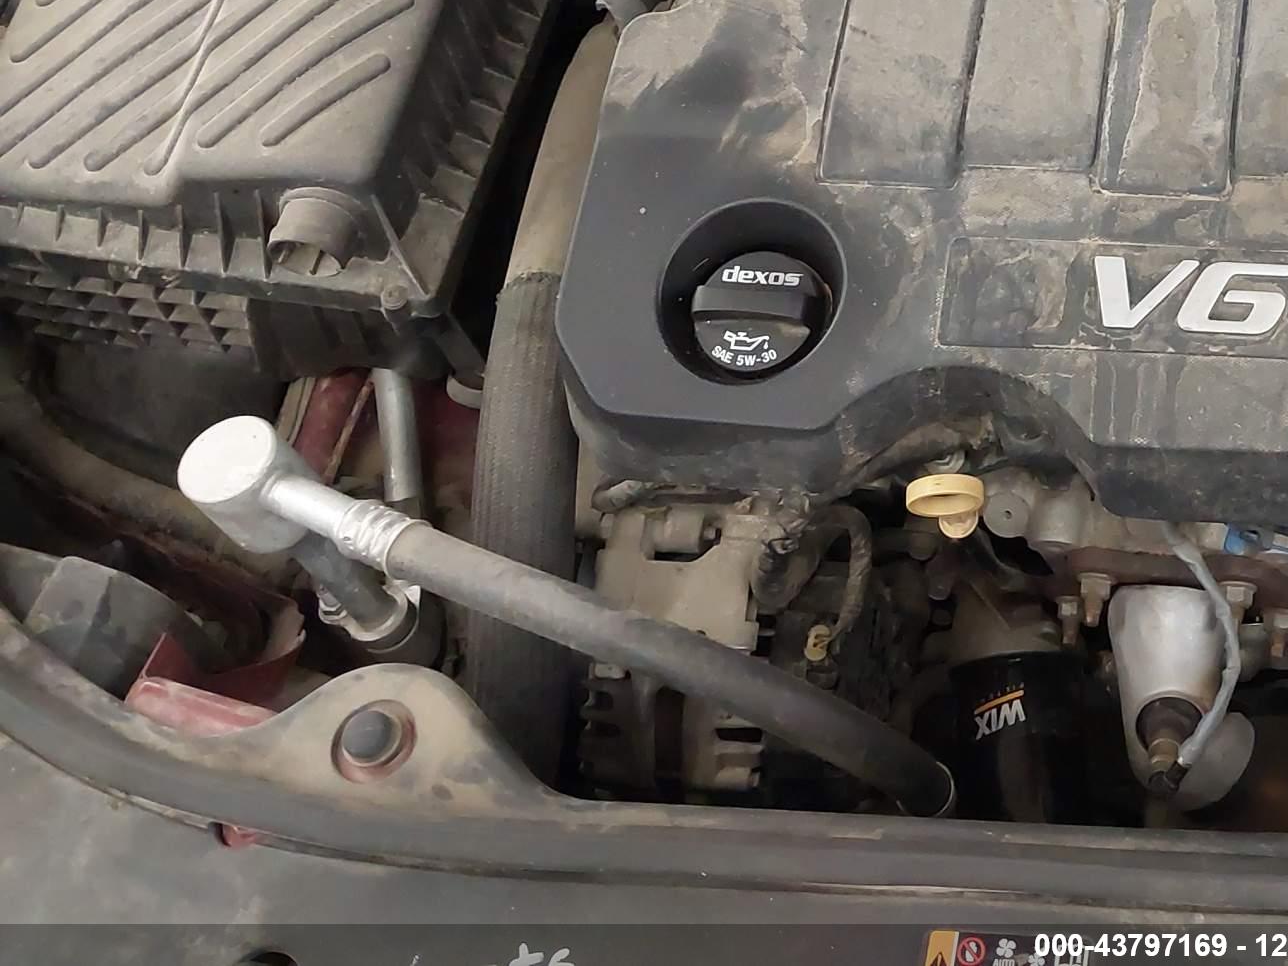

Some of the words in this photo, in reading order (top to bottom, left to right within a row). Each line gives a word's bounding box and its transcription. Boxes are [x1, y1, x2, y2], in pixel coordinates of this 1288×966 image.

[722, 266, 804, 286] dexos
[711, 345, 732, 364] SAE
[736, 349, 777, 366] 5W-30
[974, 698, 1026, 740] WIX
